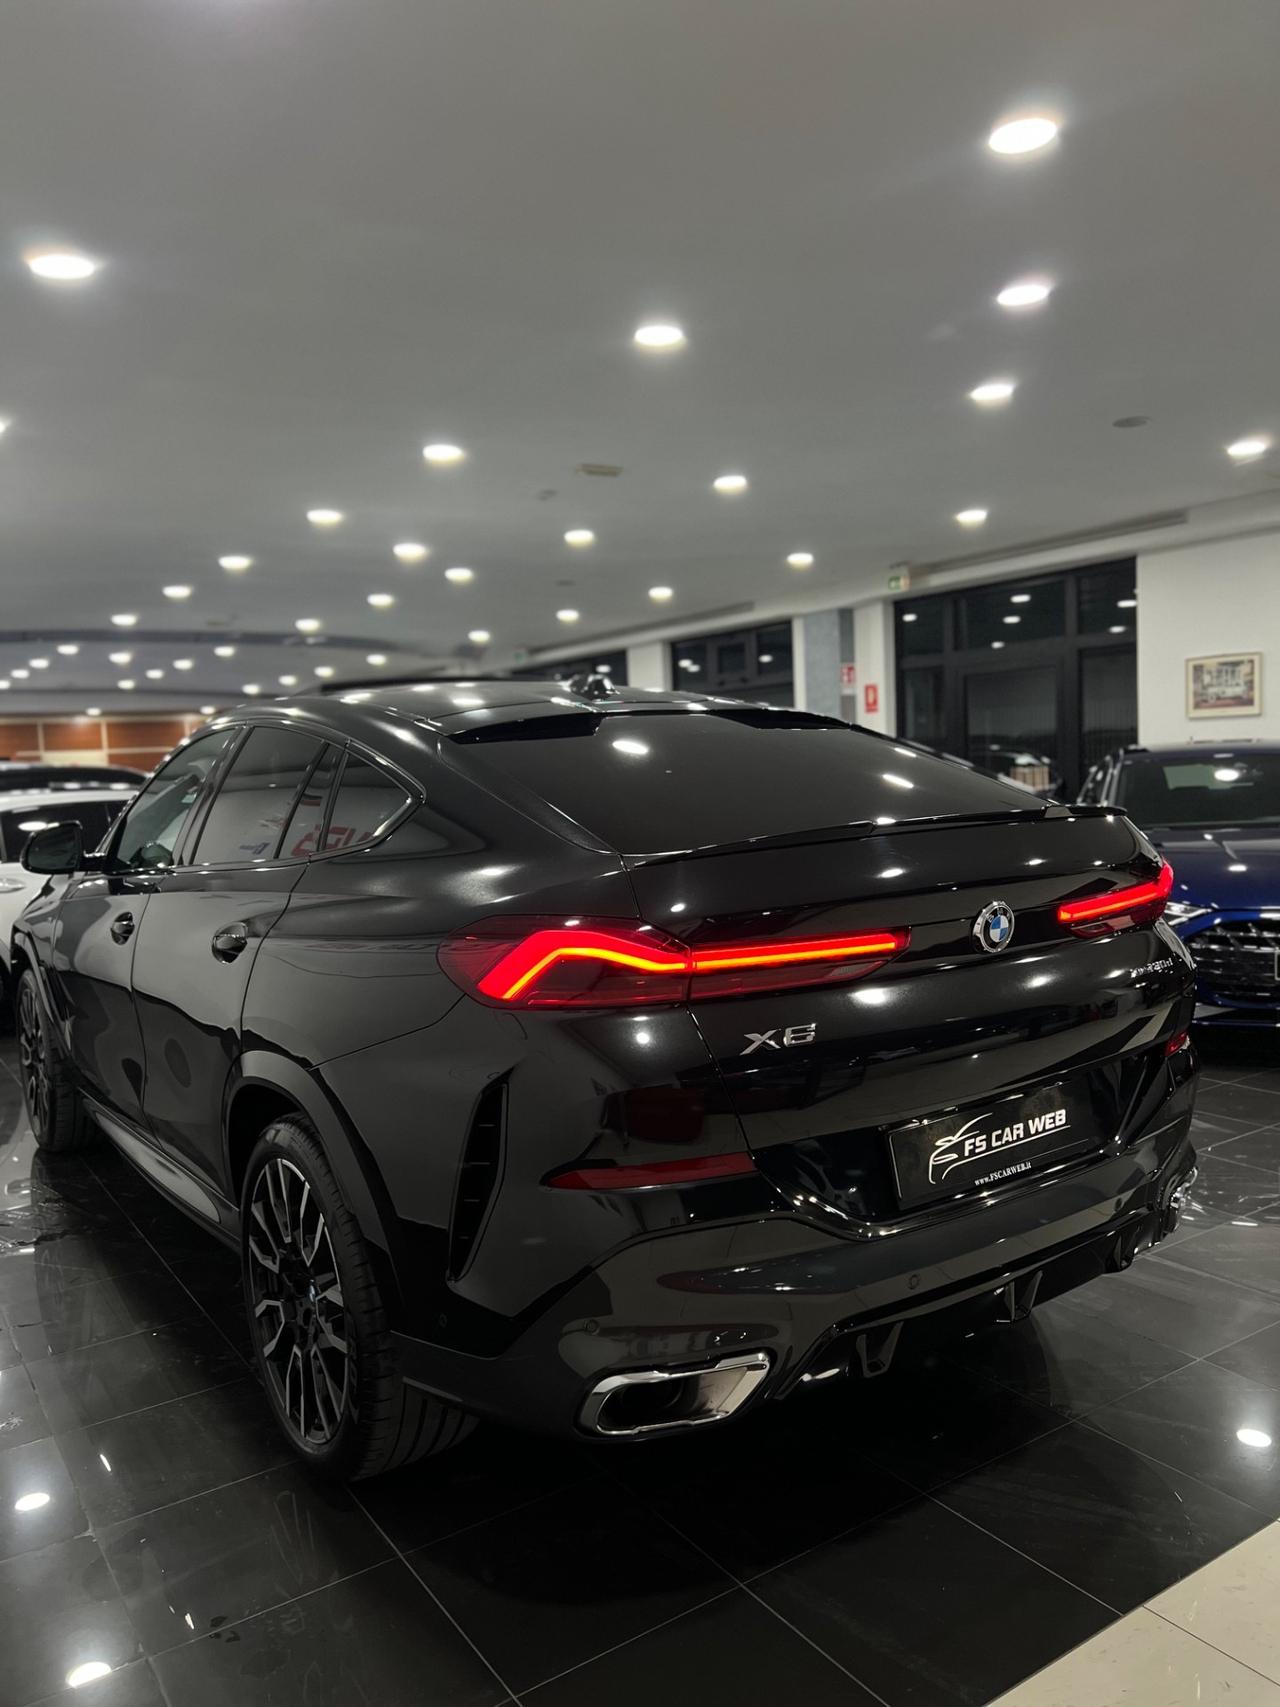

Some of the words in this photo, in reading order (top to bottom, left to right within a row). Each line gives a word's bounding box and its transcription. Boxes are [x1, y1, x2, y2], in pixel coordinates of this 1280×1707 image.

[739, 1022, 816, 1056] X6
[964, 1134, 988, 1156] FS
[991, 1122, 1025, 1146] CAR
[1028, 1108, 1067, 1135] WEB
[974, 1161, 1032, 1187] www.FSCARWEB.it
